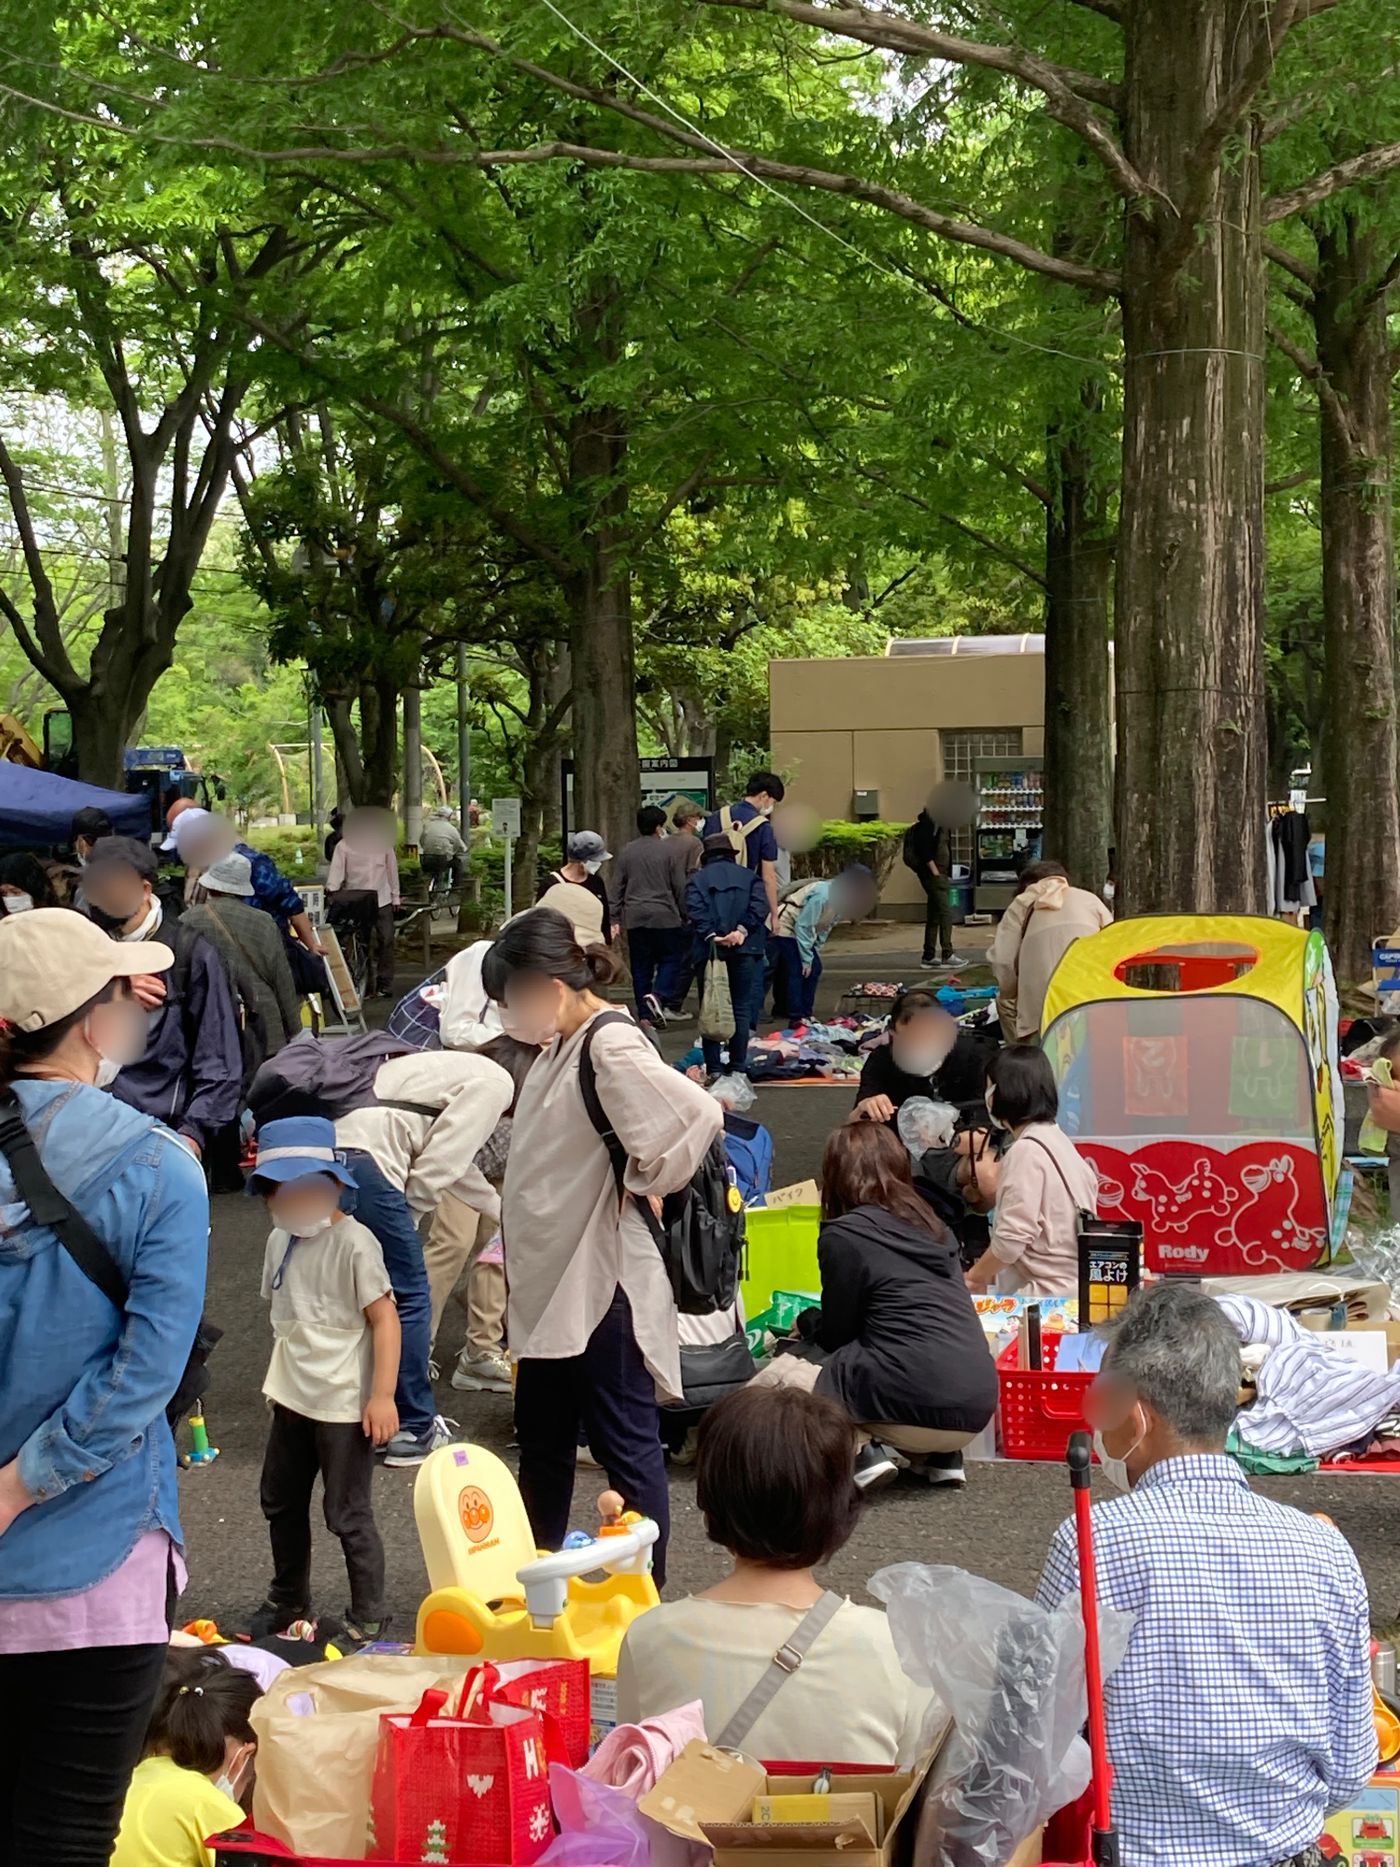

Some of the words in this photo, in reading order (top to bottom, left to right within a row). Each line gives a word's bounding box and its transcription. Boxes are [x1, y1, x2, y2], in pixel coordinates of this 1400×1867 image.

[1158, 1244, 1210, 1262] Rody
[1089, 1261, 1128, 1270] エアコンの
[1089, 1268, 1128, 1282] 風よけ
